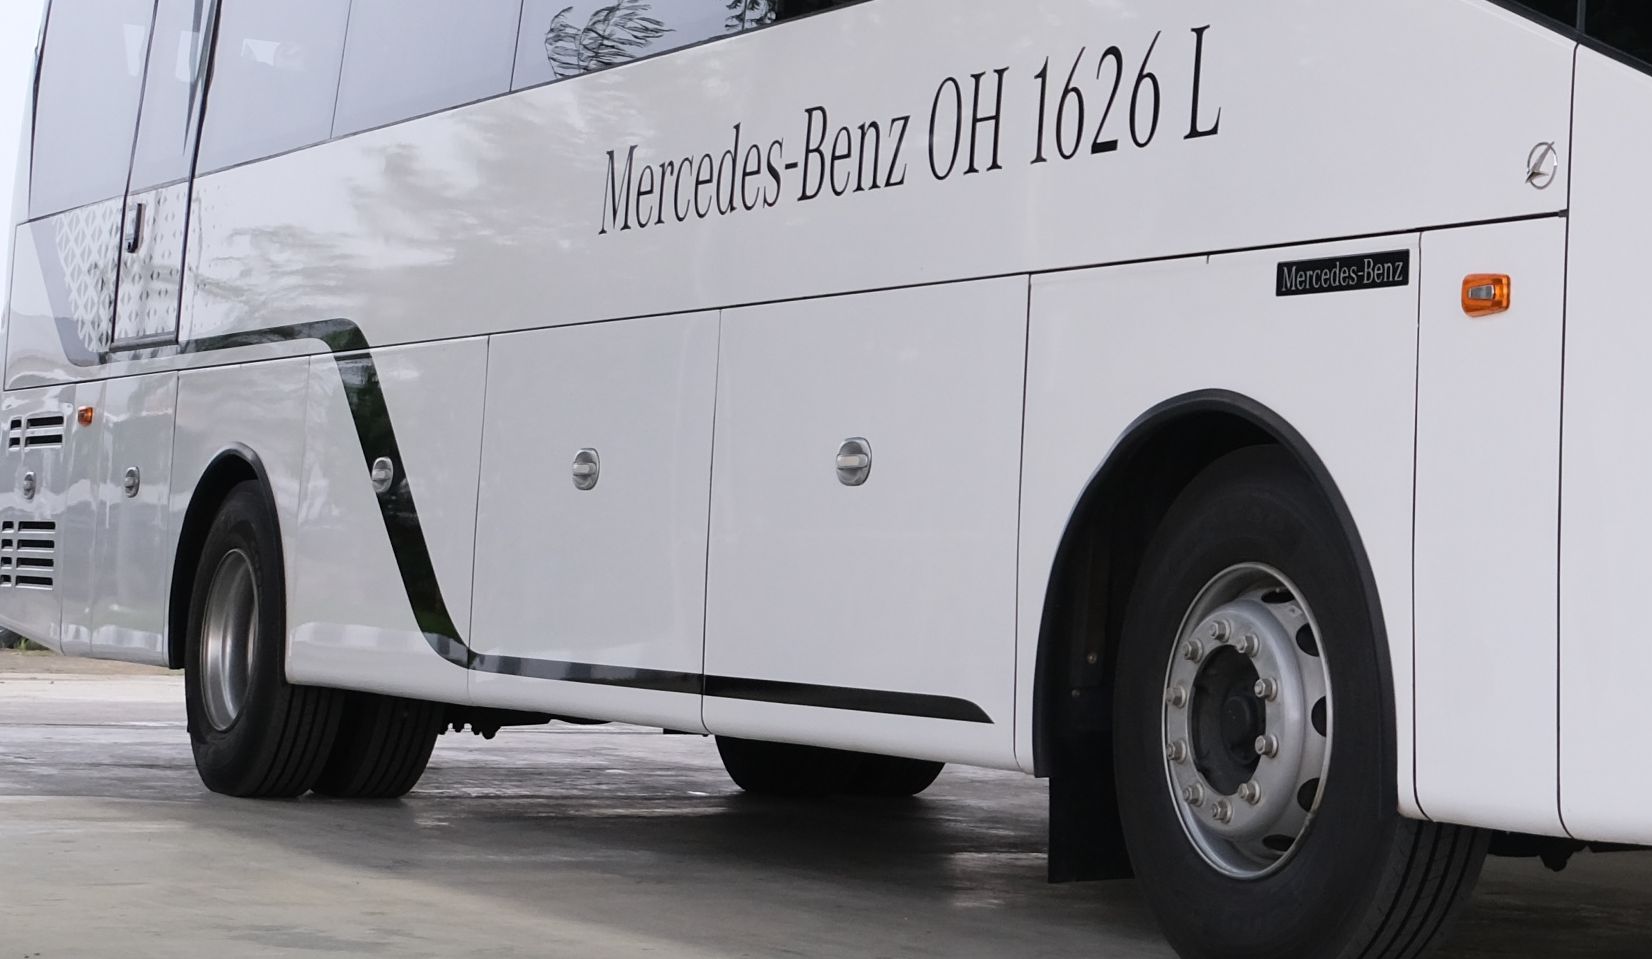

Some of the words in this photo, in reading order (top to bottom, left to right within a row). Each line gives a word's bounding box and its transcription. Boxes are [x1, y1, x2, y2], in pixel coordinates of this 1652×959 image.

[598, 105, 911, 235] Mercedes-Benz
[928, 66, 1010, 181] OH
[1030, 30, 1161, 165] 1626
[1183, 24, 1222, 140] L
[1281, 258, 1404, 291] Mercedes-Benz
